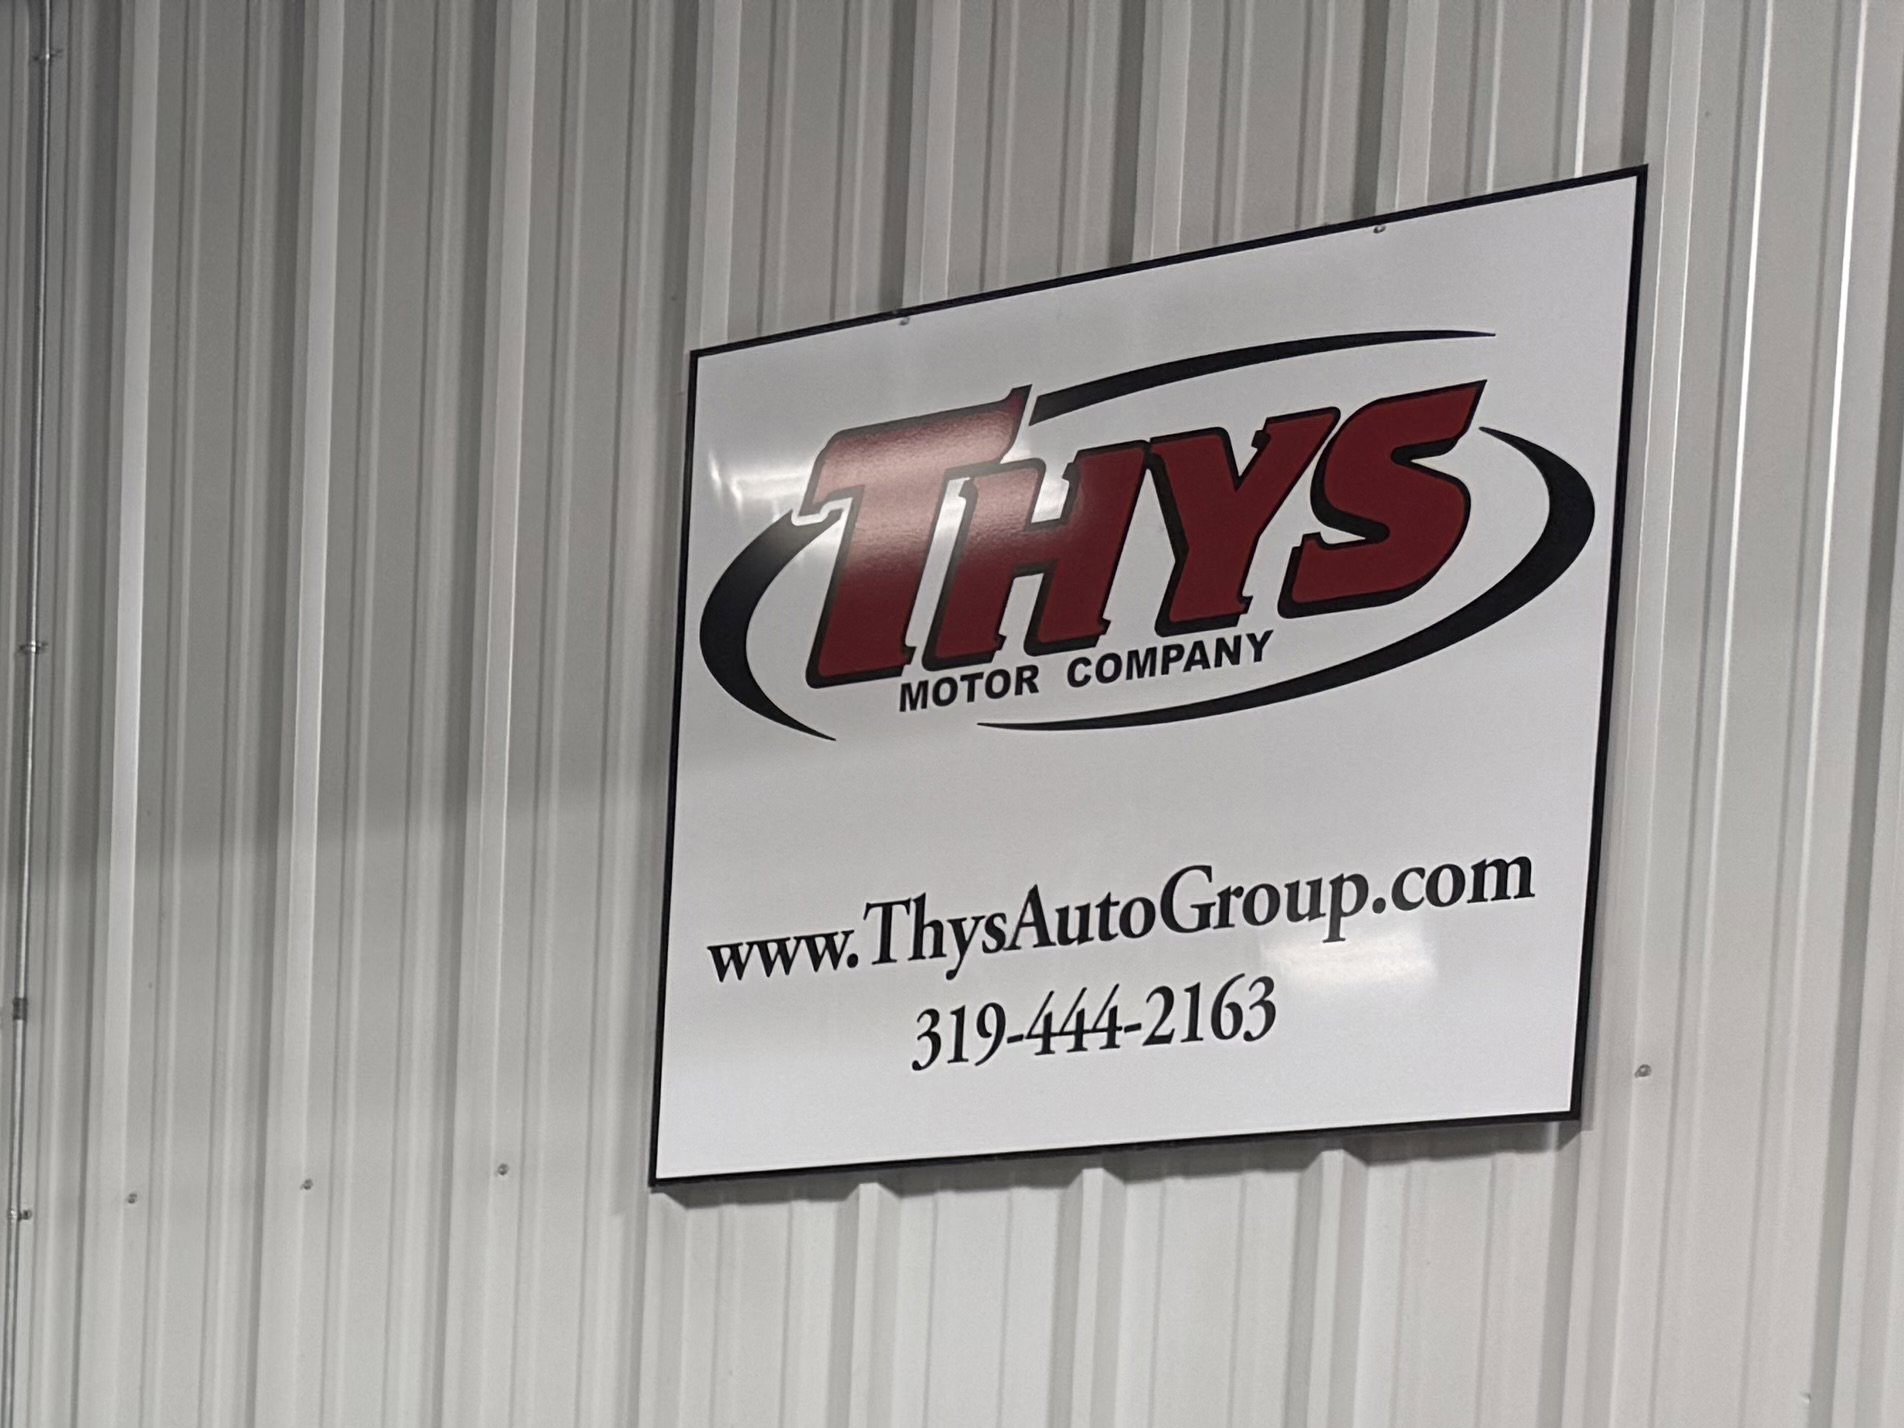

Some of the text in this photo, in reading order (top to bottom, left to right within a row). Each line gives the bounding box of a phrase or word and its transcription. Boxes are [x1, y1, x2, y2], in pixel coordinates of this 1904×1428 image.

[802, 379, 1488, 690] THYS
[898, 629, 1273, 713] MOTOR COMPANY
[707, 853, 1536, 983] www.ThysAutoGroup.com
[911, 973, 1278, 1073] 319-444-2163
